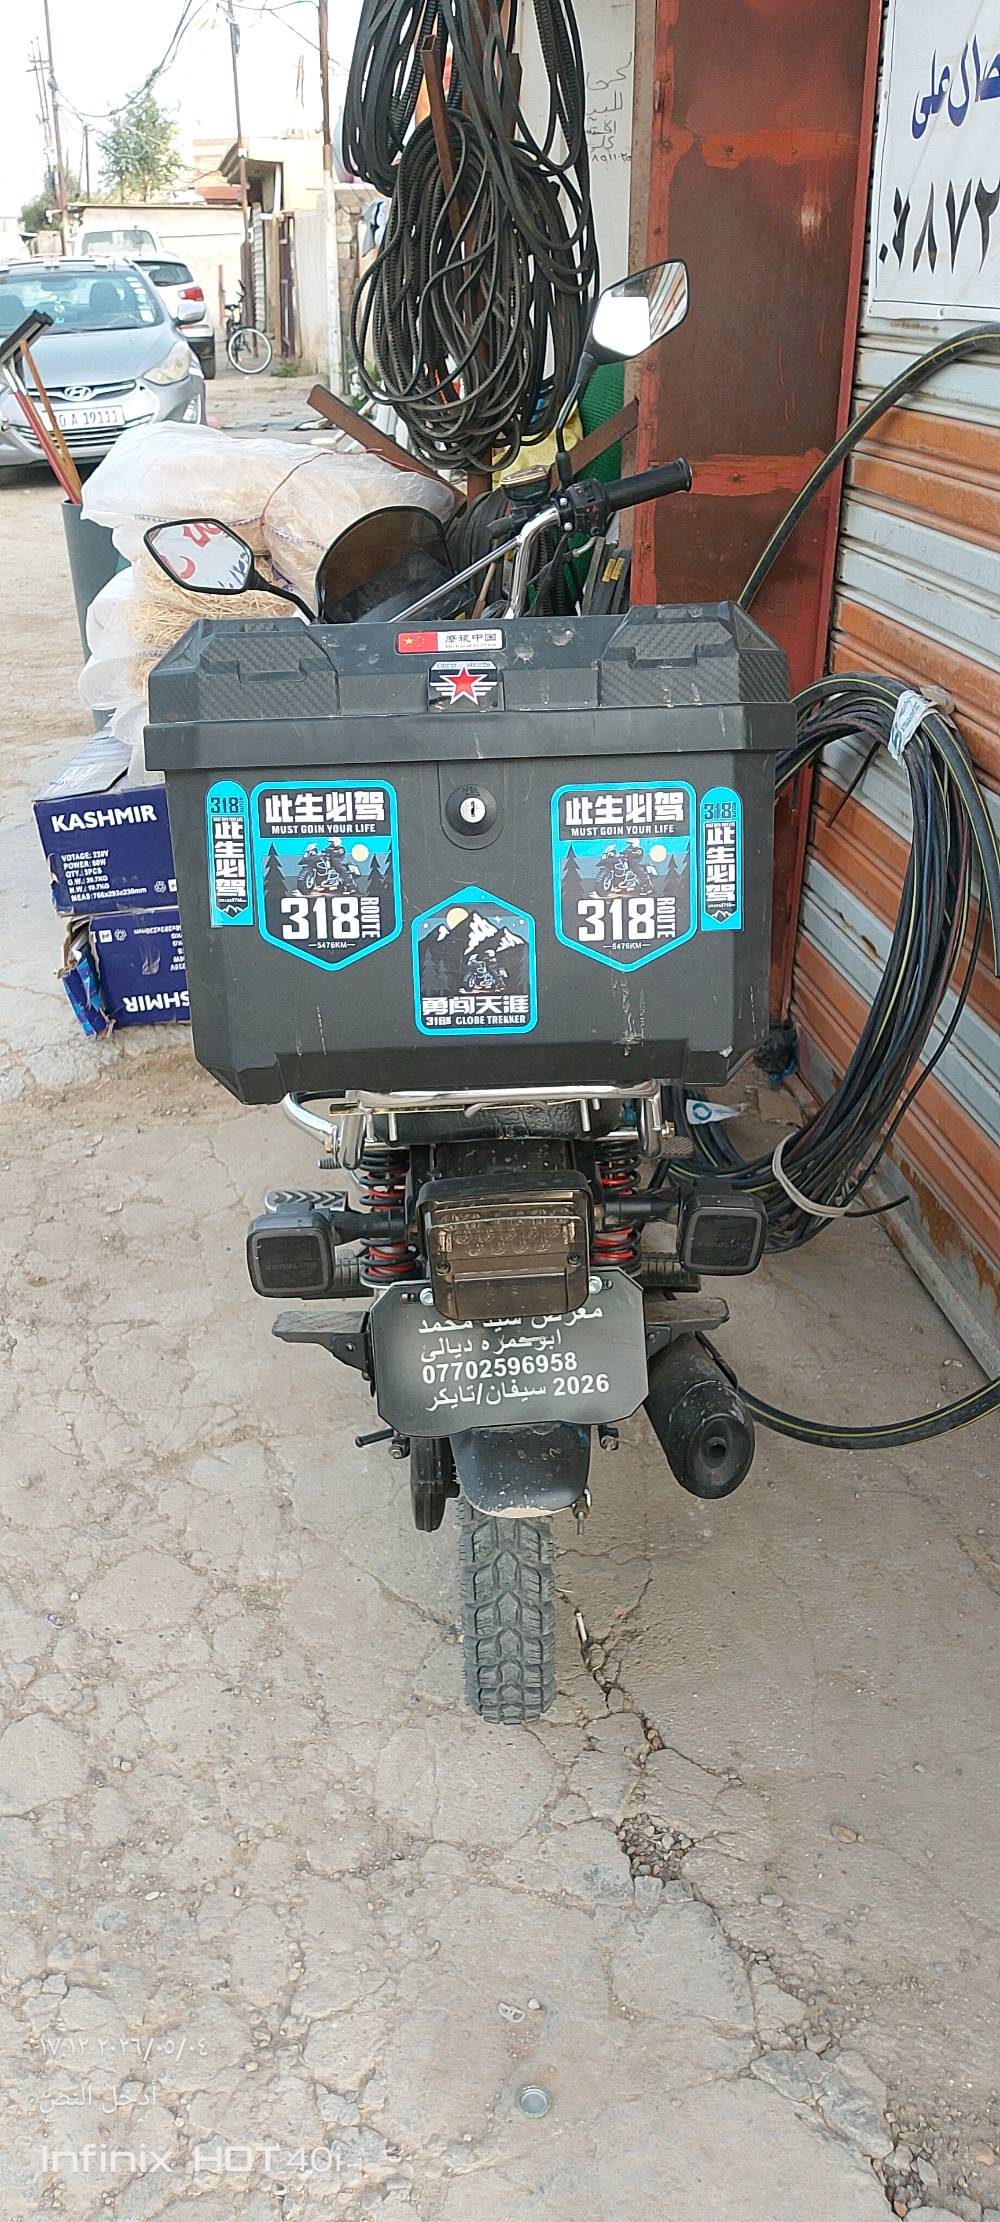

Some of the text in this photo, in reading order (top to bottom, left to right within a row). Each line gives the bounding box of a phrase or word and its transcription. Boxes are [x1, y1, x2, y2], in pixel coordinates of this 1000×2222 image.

[82, 409, 118, 425] 19111
[51, 804, 158, 833] KASHMIR
[265, 791, 385, 824] 此生必驾
[565, 791, 684, 826] 此生必驾
[271, 823, 377, 835] MUST GOIN YOUR LIFE
[570, 824, 675, 837] MUST GOIN YOUR LIFE
[214, 821, 246, 897] 此生必驾
[705, 826, 736, 902] 此生必驾
[280, 896, 381, 940] 318 ROUTE
[577, 896, 676, 942] 318 ROUTE
[421, 994, 529, 1016] 勇闯天涯
[455, 1016, 485, 1025] GLOBE
[486, 1014, 526, 1025] TREKKER
[422, 1351, 578, 1385] 07702596958
[553, 1373, 610, 1397] 2026
